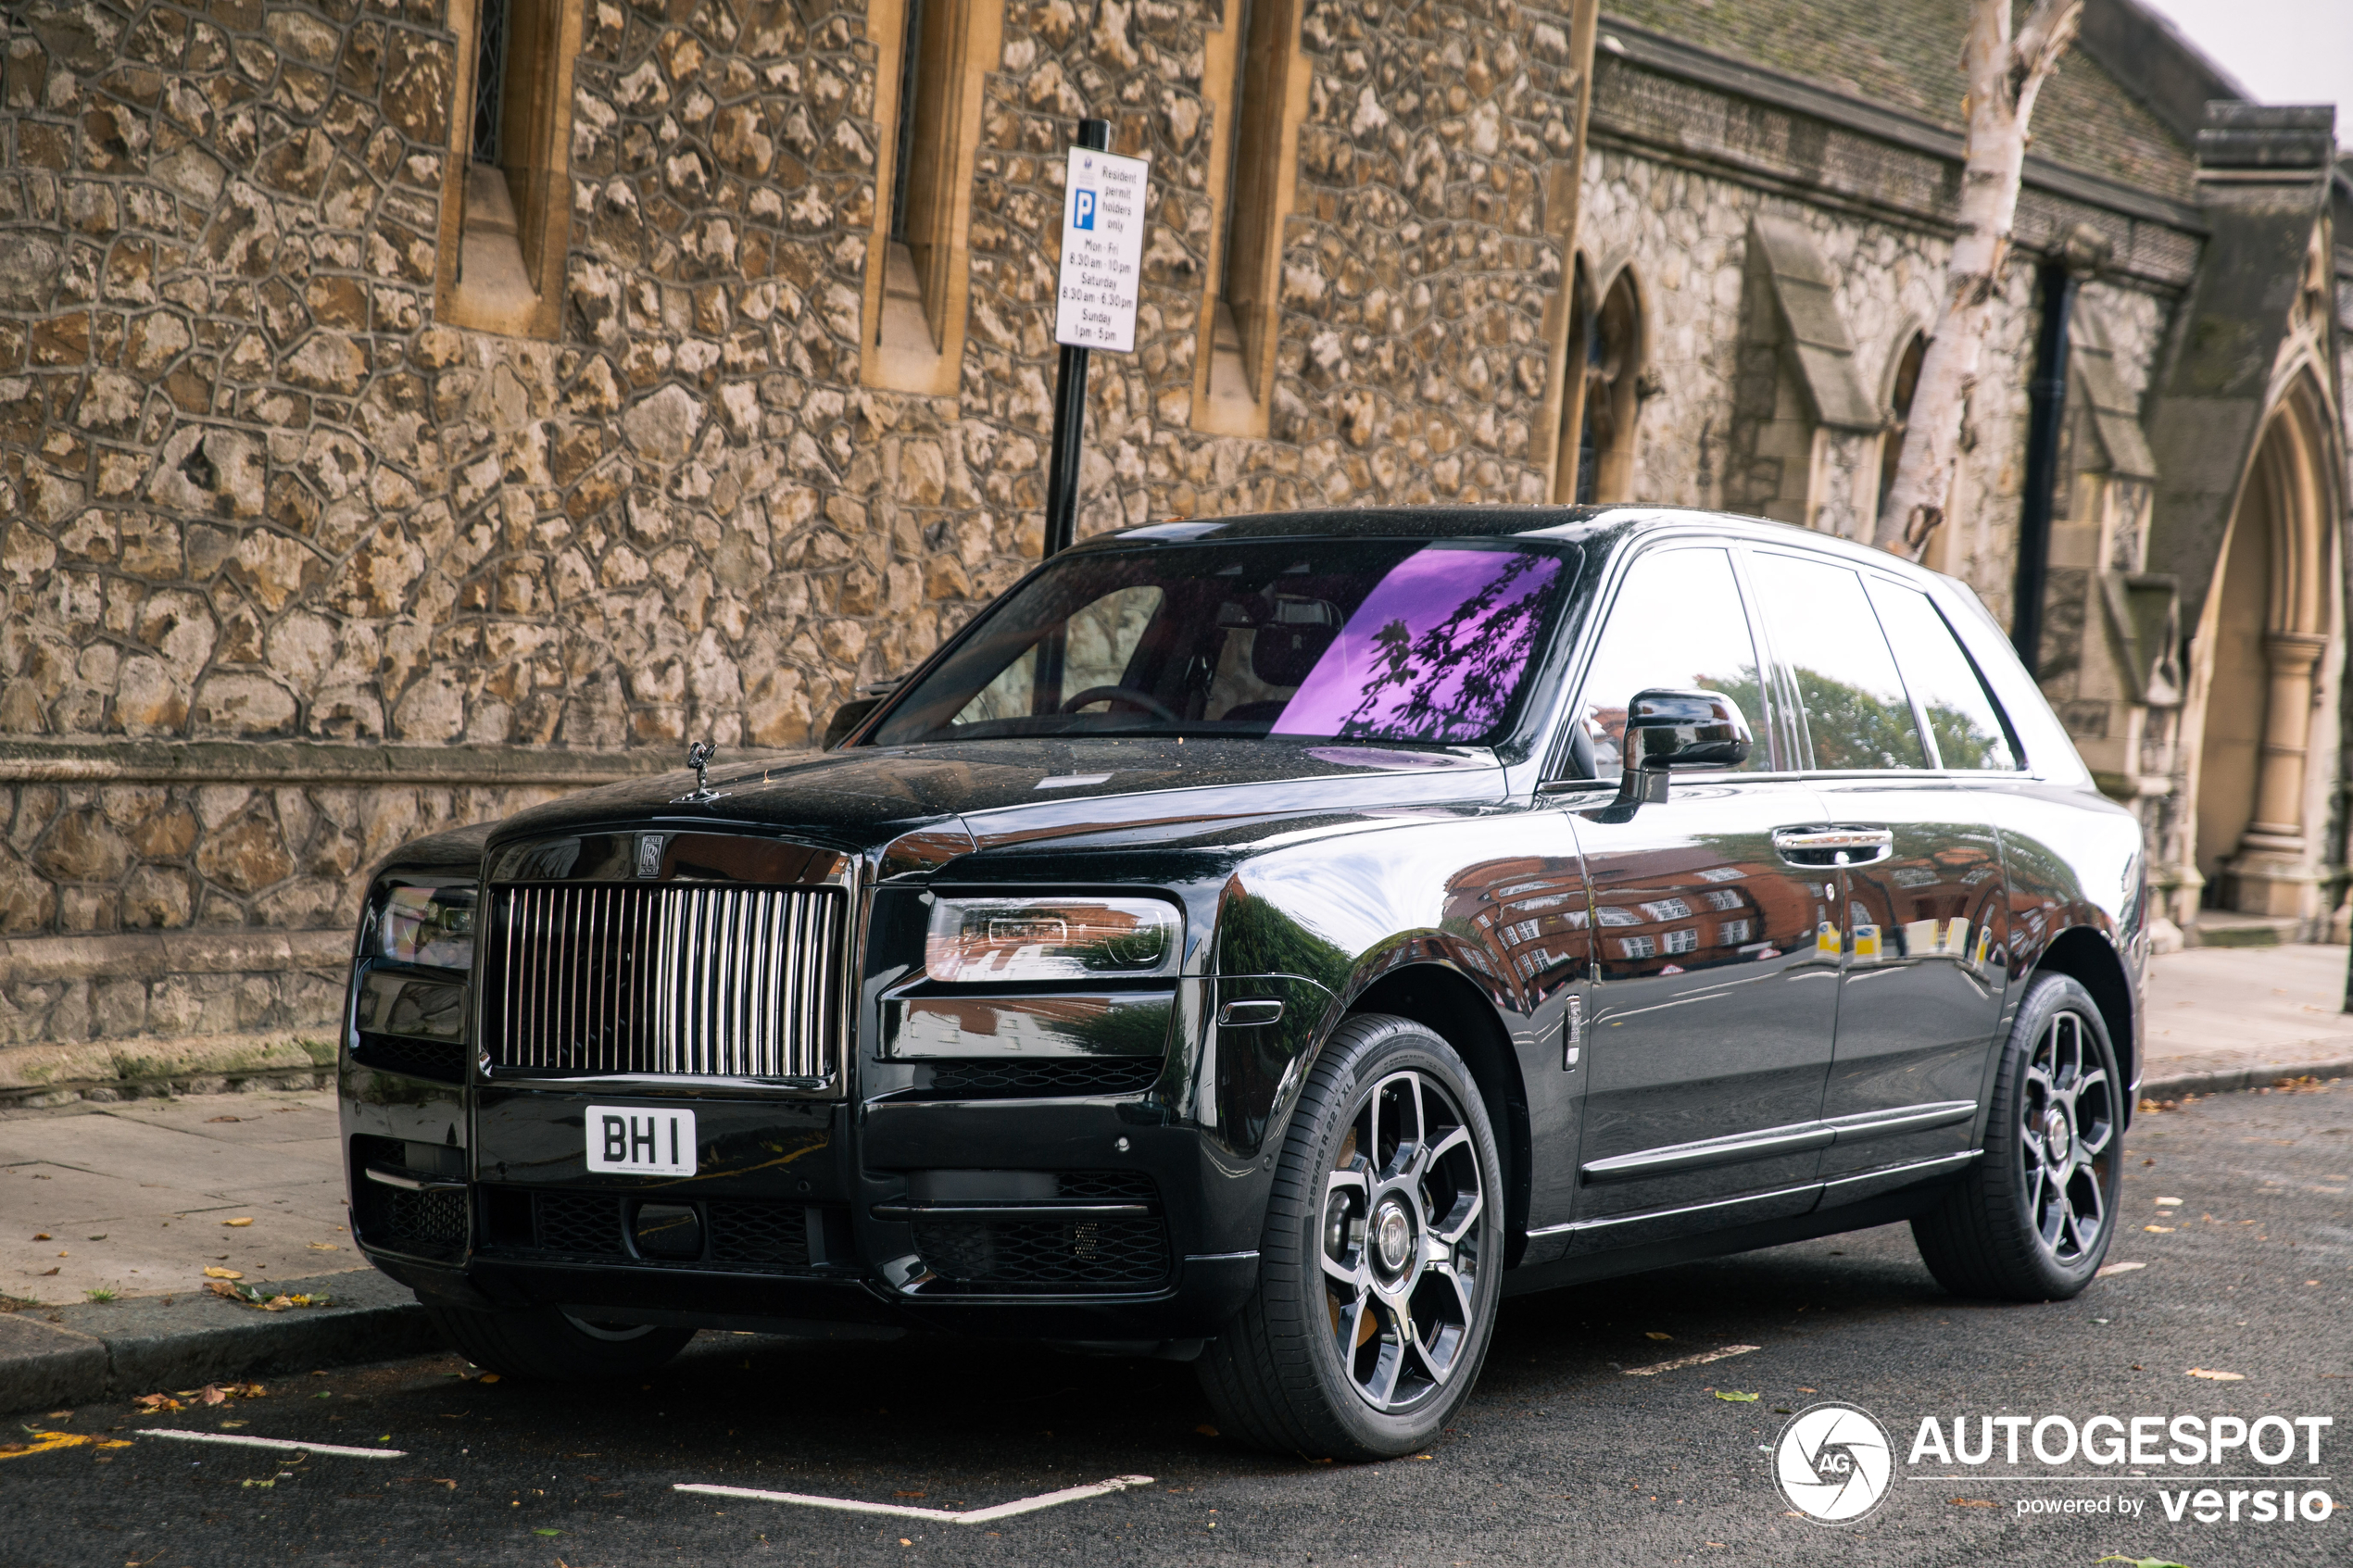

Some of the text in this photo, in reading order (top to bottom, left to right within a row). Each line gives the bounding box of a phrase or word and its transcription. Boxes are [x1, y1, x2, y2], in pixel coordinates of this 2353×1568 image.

[1102, 166, 1137, 183] Resident
[1105, 186, 1131, 199] permit
[1076, 191, 1093, 227] P
[1102, 200, 1132, 216] holders
[1107, 219, 1124, 232] only
[1085, 238, 1101, 252] Mon
[1109, 242, 1119, 254] Fri
[1081, 271, 1117, 291] Saturday
[1082, 307, 1112, 326] Sunday
[1327, 1110, 1338, 1133] 22
[602, 1114, 656, 1163] BH
